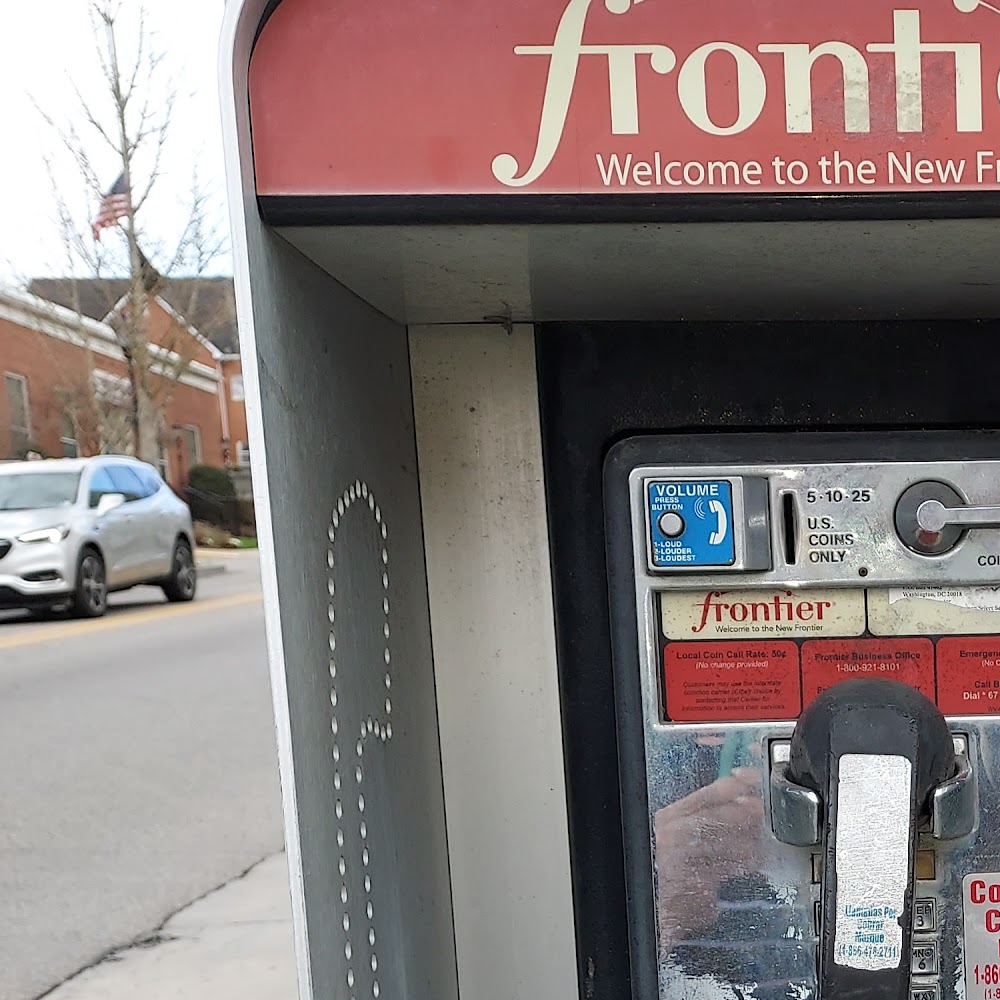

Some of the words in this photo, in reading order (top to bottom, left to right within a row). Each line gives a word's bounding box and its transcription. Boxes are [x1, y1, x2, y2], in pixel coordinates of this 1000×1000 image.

[596, 152, 762, 186] Welcome
[772, 156, 808, 185] to
[818, 150, 876, 184] the
[888, 152, 966, 184] New
[656, 484, 720, 496] VOLUME
[808, 518, 834, 530] U.S.
[809, 534, 854, 546] COINS
[809, 551, 847, 563] ONLY
[692, 590, 831, 633] frontier
[794, 624, 823, 632] Frontier
[736, 660, 768, 669] provided)
[836, 663, 900, 672] 1-800-921-8101
[982, 660, 994, 668] (No
[963, 692, 980, 700] Dial
[917, 916, 924, 926] 3
[918, 958, 926, 970] 6
